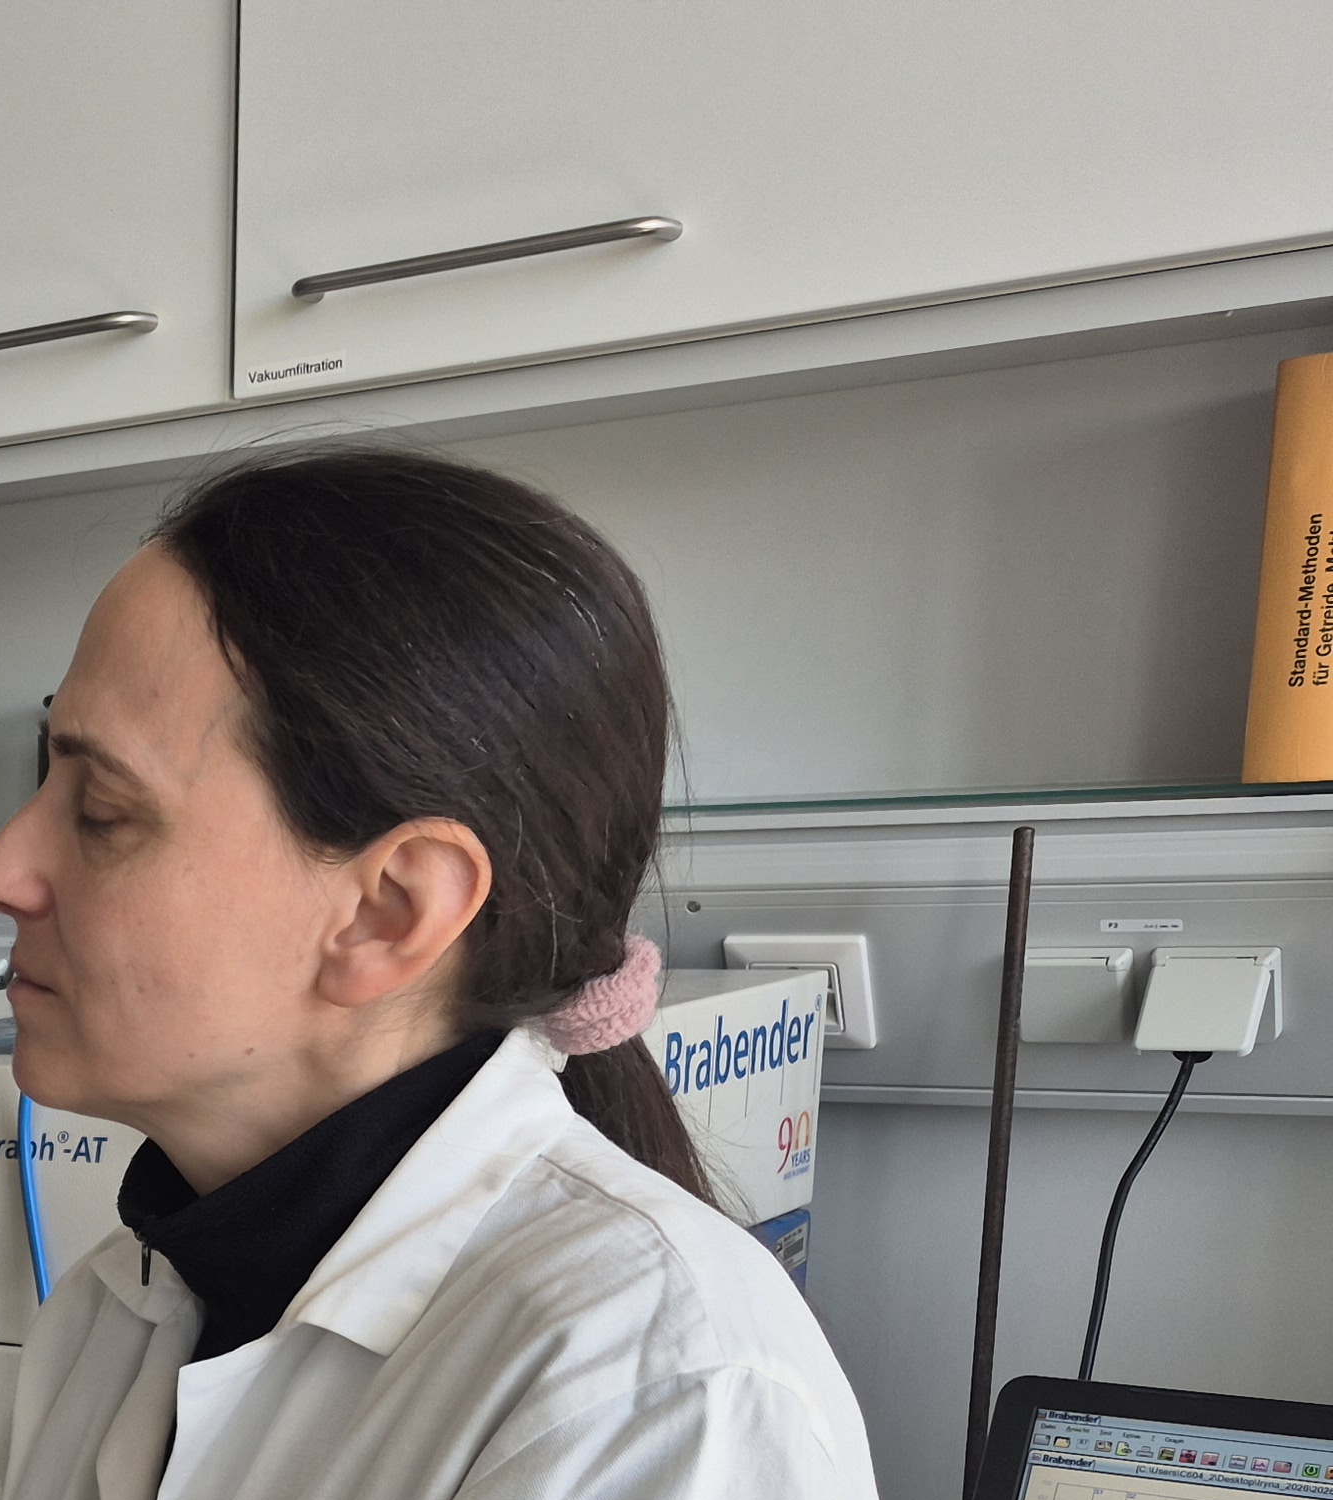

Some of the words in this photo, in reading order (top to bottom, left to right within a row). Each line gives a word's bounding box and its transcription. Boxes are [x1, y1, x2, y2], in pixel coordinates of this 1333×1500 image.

[248, 358, 343, 384] Vakuumfiltration
[1288, 512, 1323, 688] Standard-Methoden
[1312, 662, 1330, 687] für
[791, 1148, 811, 1168] YEARS
[1048, 1411, 1100, 1424] Brabender
[1043, 1454, 1093, 1468] Brabender
